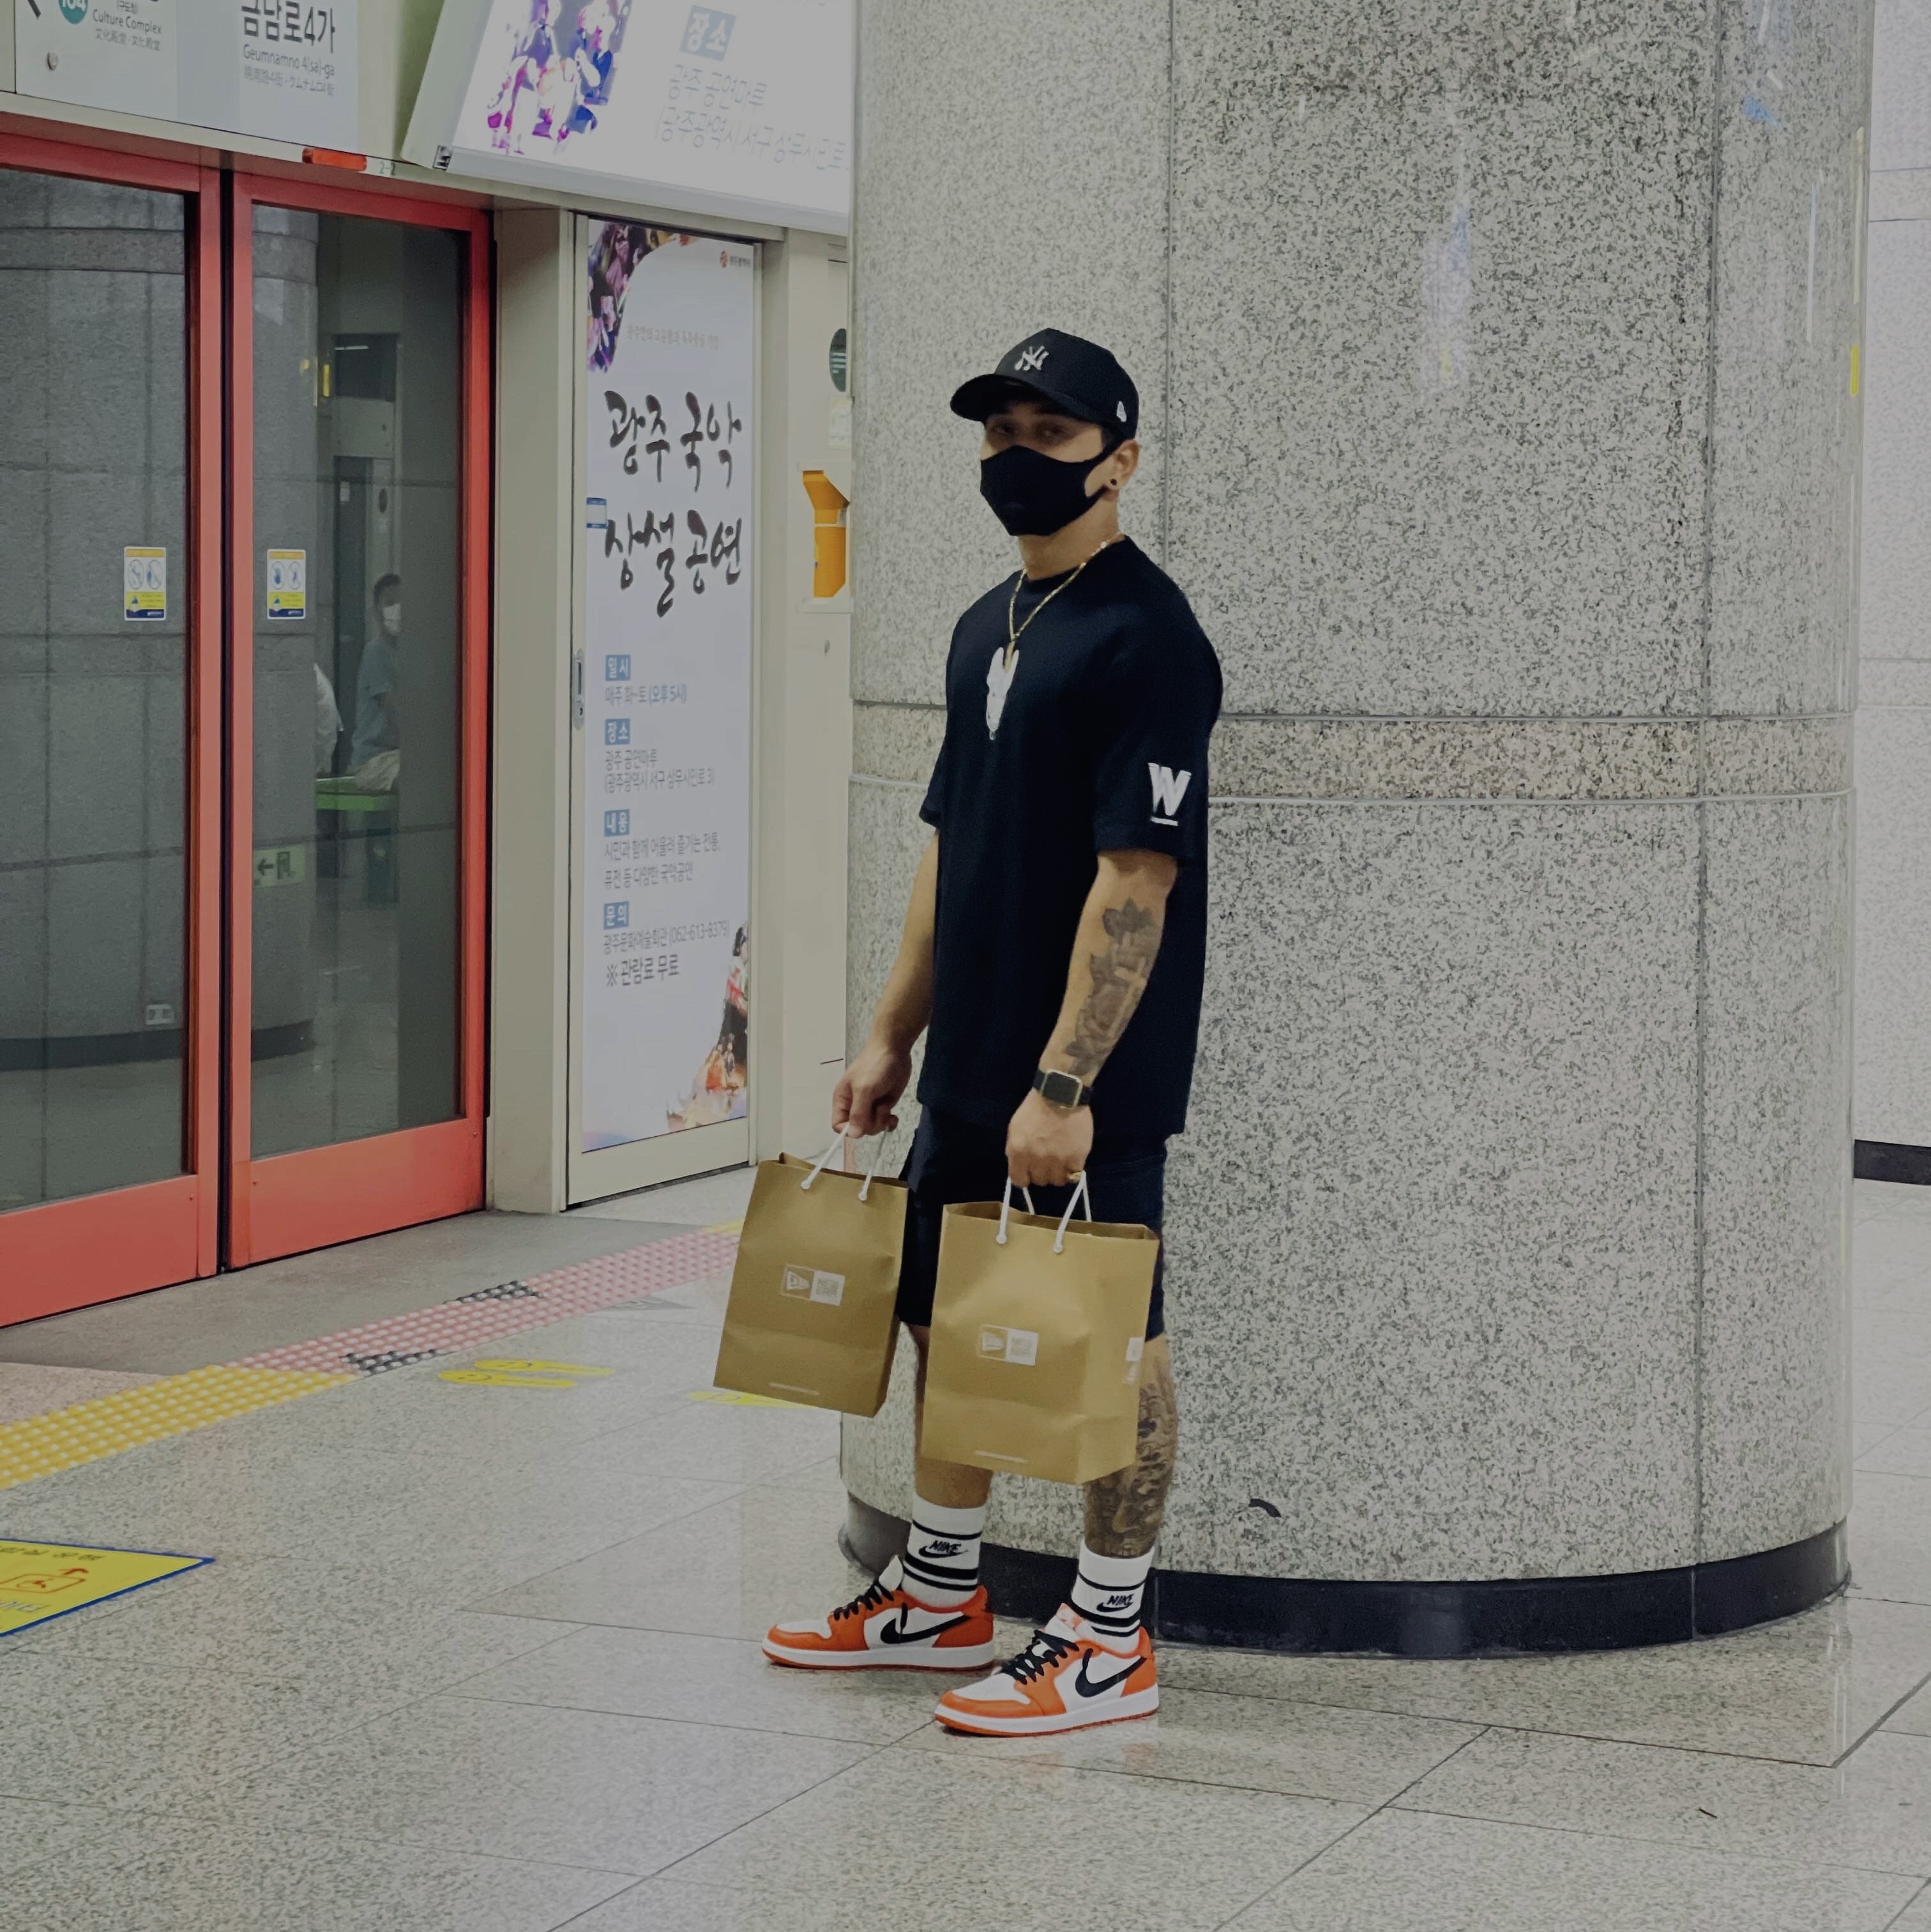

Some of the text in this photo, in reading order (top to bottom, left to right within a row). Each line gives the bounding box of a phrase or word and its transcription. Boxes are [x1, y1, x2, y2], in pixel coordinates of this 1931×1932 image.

[93, 9, 162, 34] Culture Complex
[687, 12, 726, 52] 장소
[243, 43, 299, 69] Geumnamno
[604, 390, 742, 492] 광주 국악
[604, 509, 742, 618] 상설 공연
[607, 657, 628, 679] 일시
[607, 722, 628, 743] 장소
[605, 749, 658, 772] 광주 공연마루
[606, 811, 628, 833] 내용
[606, 903, 628, 927] 문의
[621, 957, 654, 987] 관람료
[657, 954, 679, 981] 무료
[929, 1540, 962, 1554] NIKE
[1106, 1594, 1135, 1606] NIKE
